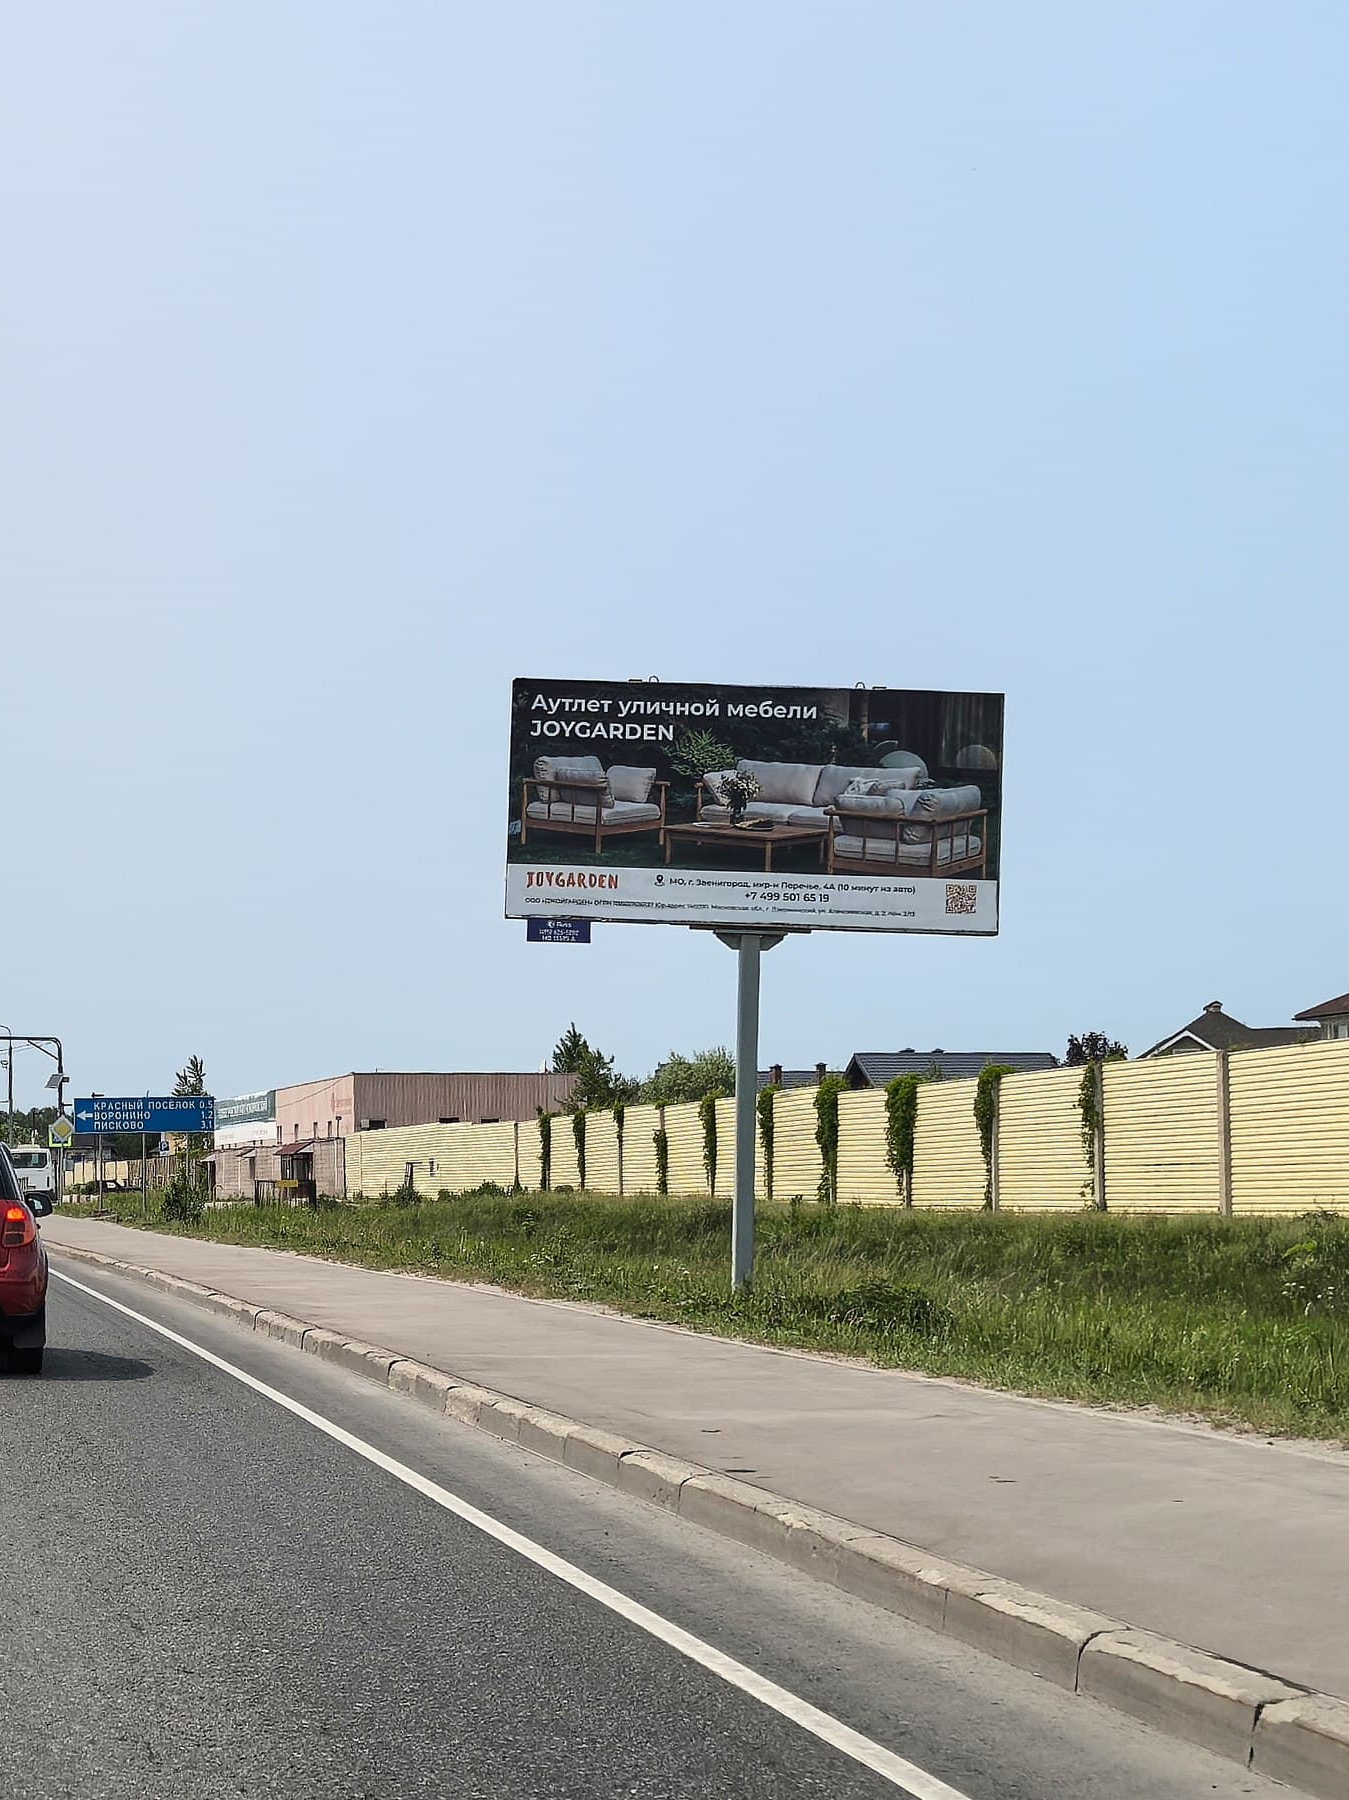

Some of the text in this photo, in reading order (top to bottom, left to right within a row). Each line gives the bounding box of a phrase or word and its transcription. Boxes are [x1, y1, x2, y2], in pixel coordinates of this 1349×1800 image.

[531, 694, 817, 719] Аутлет уличной мебели
[530, 720, 674, 741] JOYGARDEN
[526, 871, 619, 889] JOYGARDEN
[837, 883, 849, 892] (10
[745, 891, 830, 903] +7 499 501 65 19
[93, 1100, 144, 1111] КРАСНЫЙ
[94, 1111, 151, 1120] ВОРОНИНО
[93, 1121, 144, 1130] ПИСКОВО
